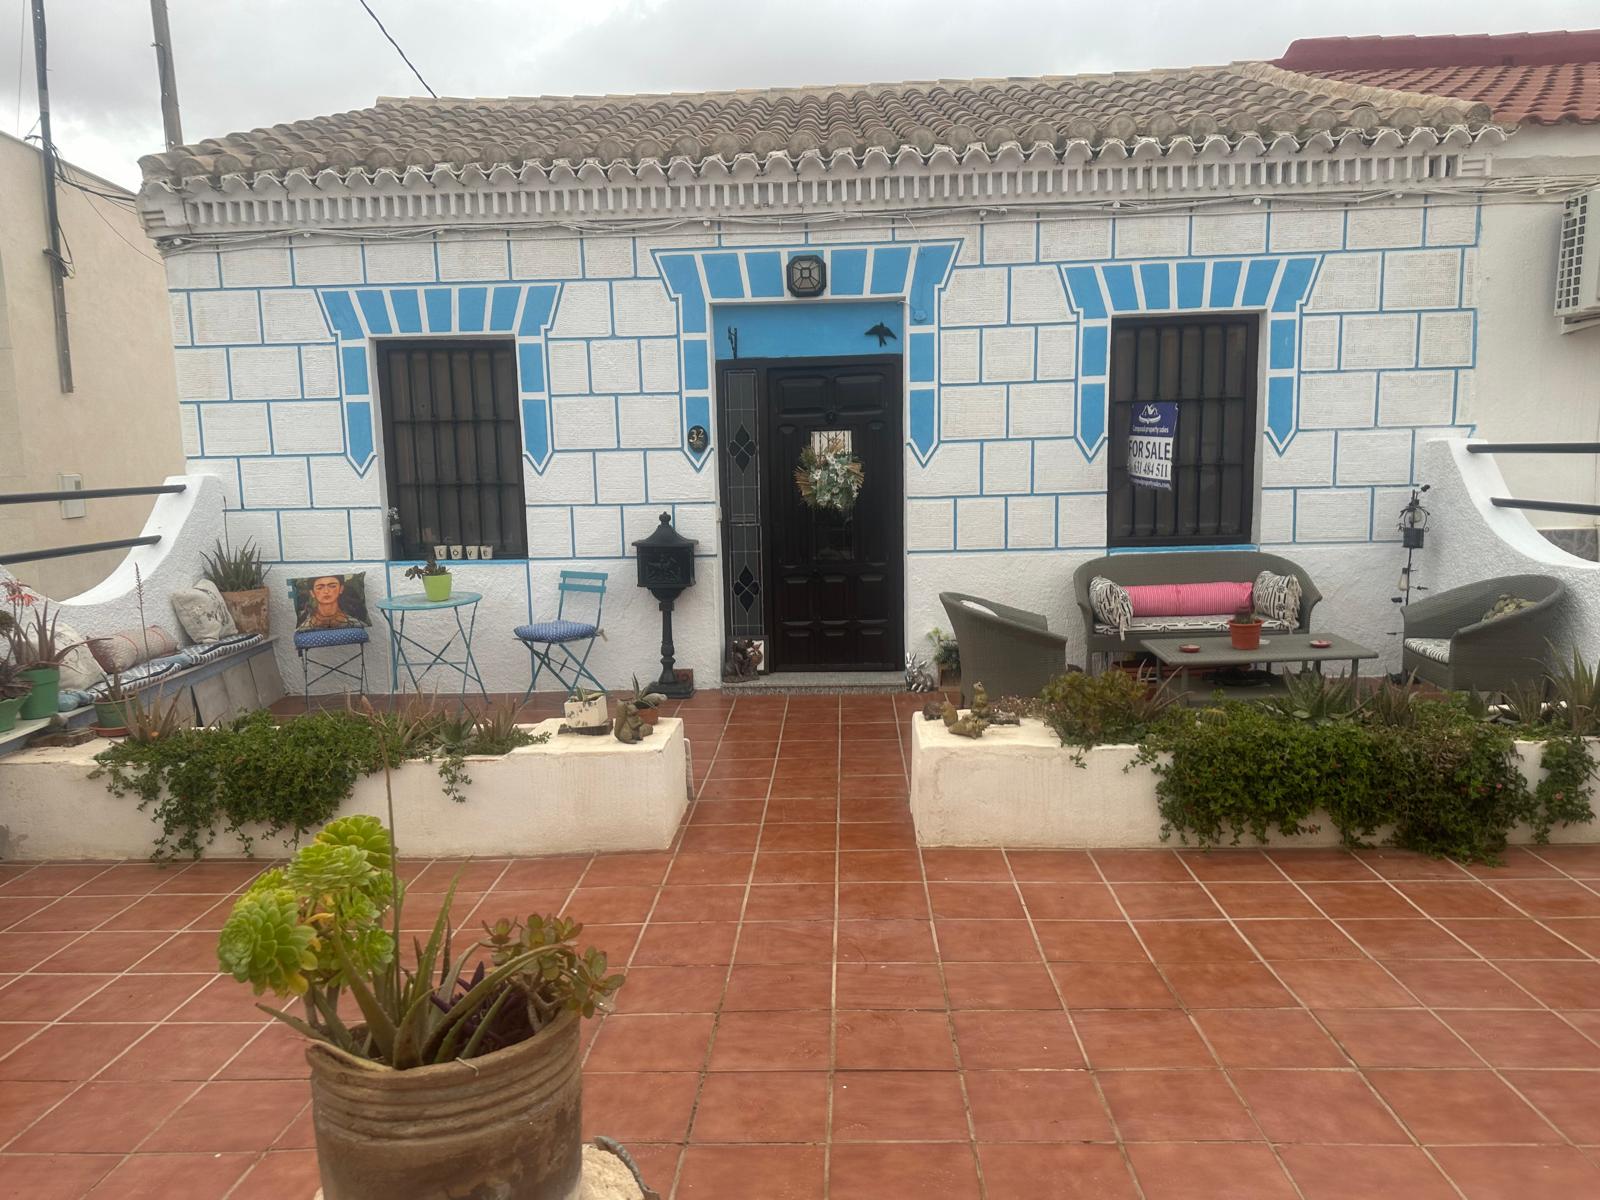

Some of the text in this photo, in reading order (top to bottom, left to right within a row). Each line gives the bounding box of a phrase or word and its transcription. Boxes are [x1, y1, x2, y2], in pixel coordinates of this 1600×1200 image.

[1129, 440, 1171, 460] FOR SALE
[1155, 463, 1168, 477] 511
